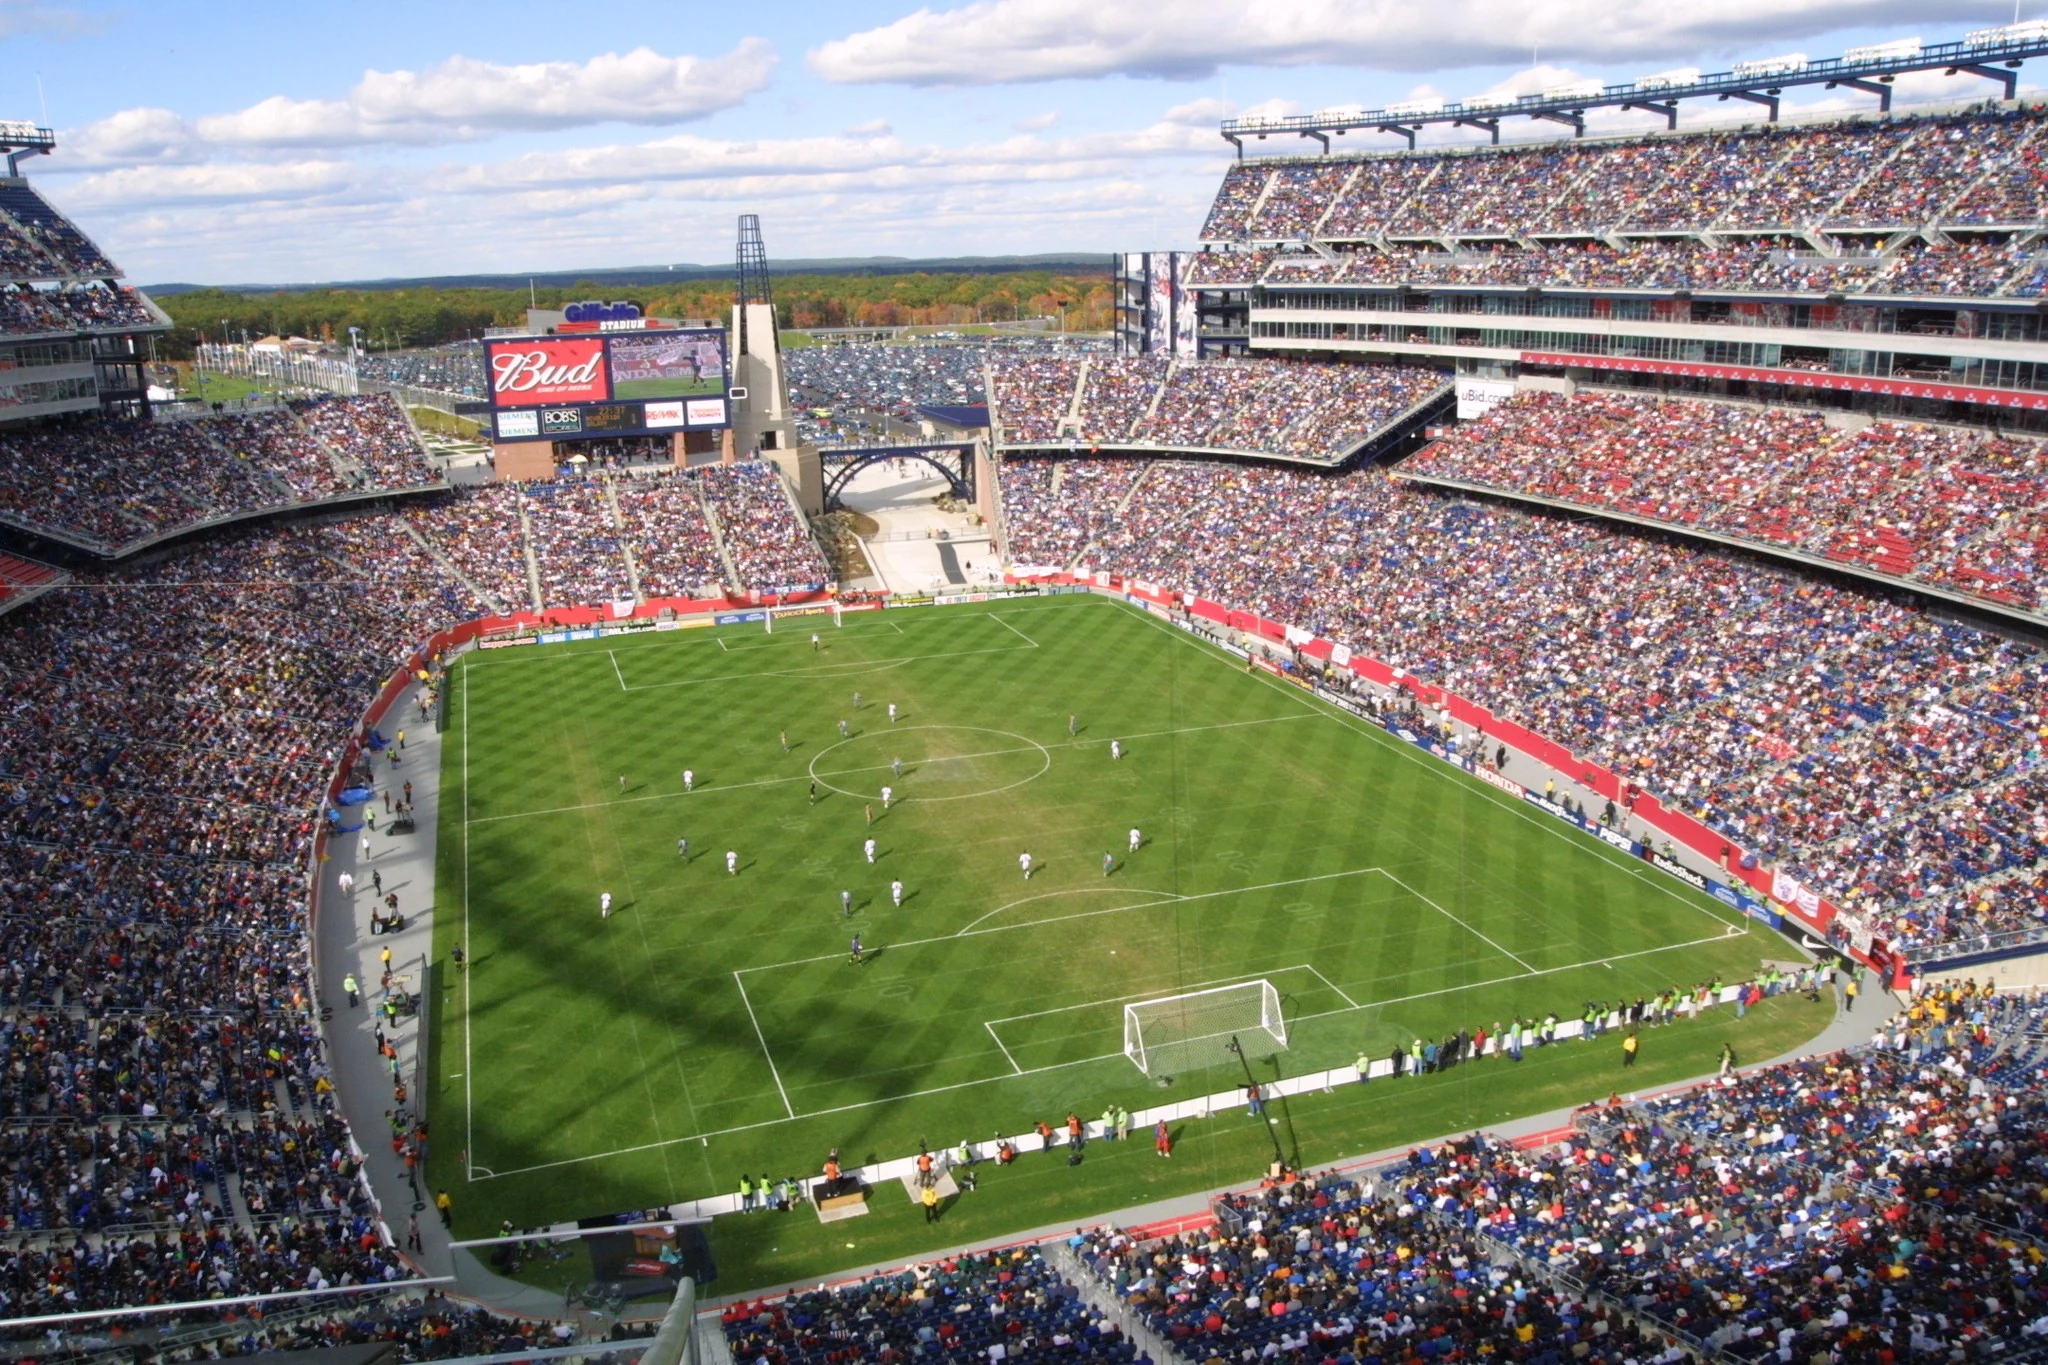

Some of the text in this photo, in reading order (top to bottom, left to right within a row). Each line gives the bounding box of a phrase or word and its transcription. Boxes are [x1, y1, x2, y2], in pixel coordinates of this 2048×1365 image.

[563, 301, 641, 322] Gillette
[600, 320, 646, 330] STADIUM
[492, 351, 602, 392] Bud
[536, 385, 555, 393] KING
[500, 426, 538, 435] SIEMENS
[1475, 763, 1525, 799] HONDA
[1599, 827, 1633, 851] PEPSI
